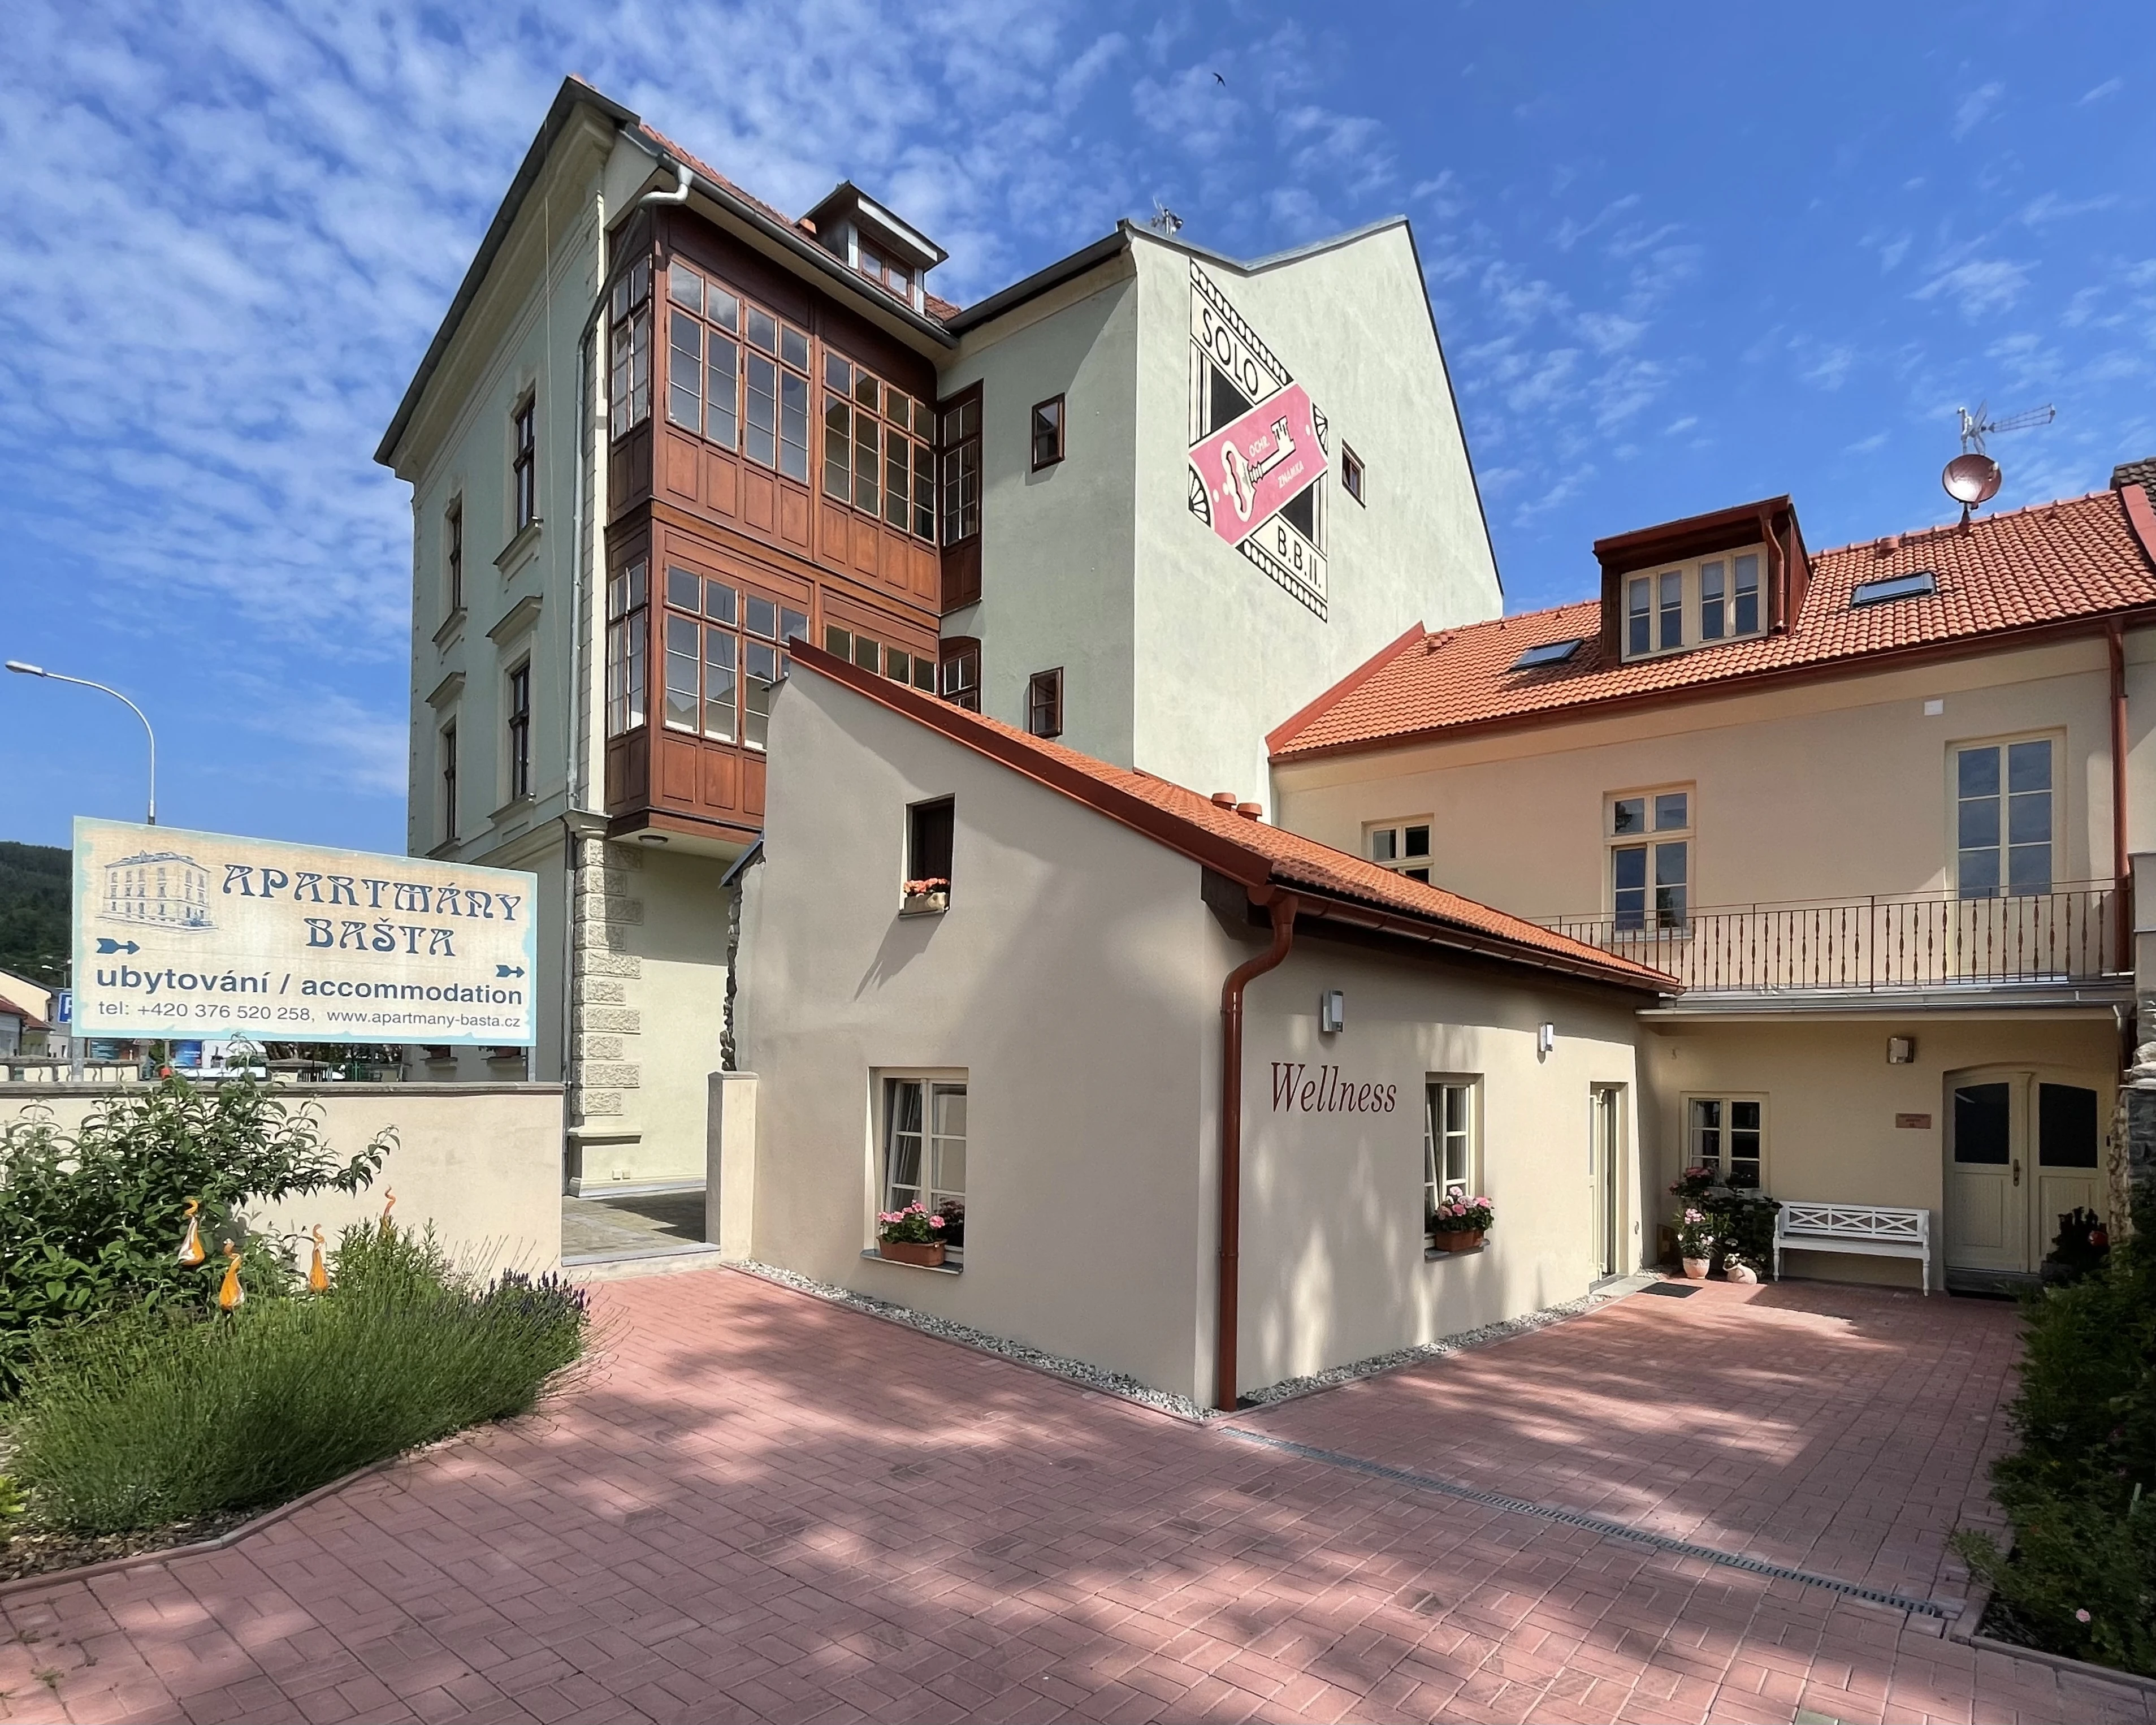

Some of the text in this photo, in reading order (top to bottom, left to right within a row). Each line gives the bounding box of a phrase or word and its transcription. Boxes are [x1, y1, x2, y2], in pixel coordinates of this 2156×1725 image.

[1202, 308, 1258, 396] SOLO
[222, 863, 521, 921] APARTMÁNY
[304, 916, 456, 957] BAŠTA
[97, 965, 271, 995] ubytování
[301, 979, 522, 1005] accommodation
[98, 1001, 521, 1028] tel: +420 376 520 258, www.apartmany-basta.cz
[1271, 1062, 1397, 1113] Wellness
